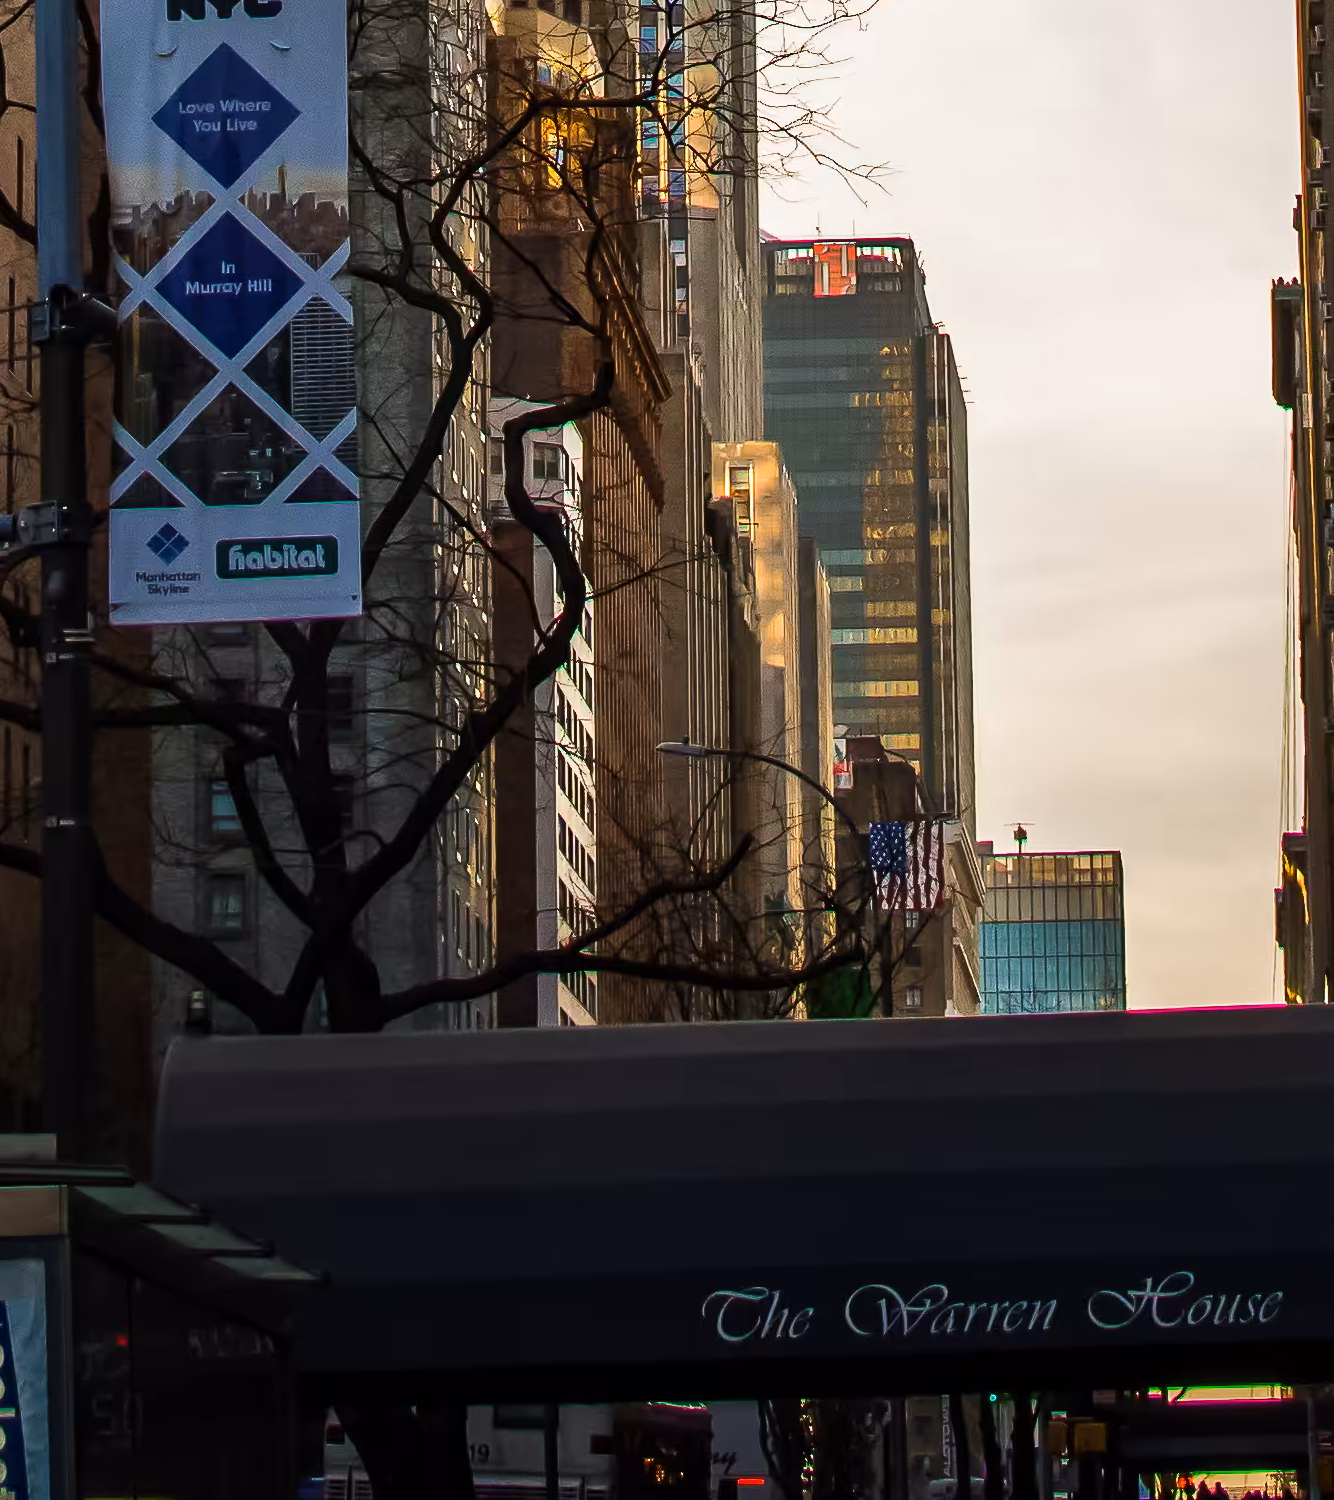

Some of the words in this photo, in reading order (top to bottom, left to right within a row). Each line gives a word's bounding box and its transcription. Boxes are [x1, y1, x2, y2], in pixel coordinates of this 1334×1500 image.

[178, 101, 215, 114] Love
[220, 99, 272, 112] Where
[193, 119, 221, 132] You
[227, 117, 258, 131] Live
[221, 260, 235, 274] In
[185, 281, 242, 295] Murray
[247, 278, 272, 292] Hill
[228, 544, 326, 570] habitat
[136, 571, 201, 584] Manhattan
[147, 584, 190, 596] Skyline
[702, 1287, 814, 1342] The
[845, 1283, 1058, 1337] Warren
[1087, 1271, 1283, 1329] House
